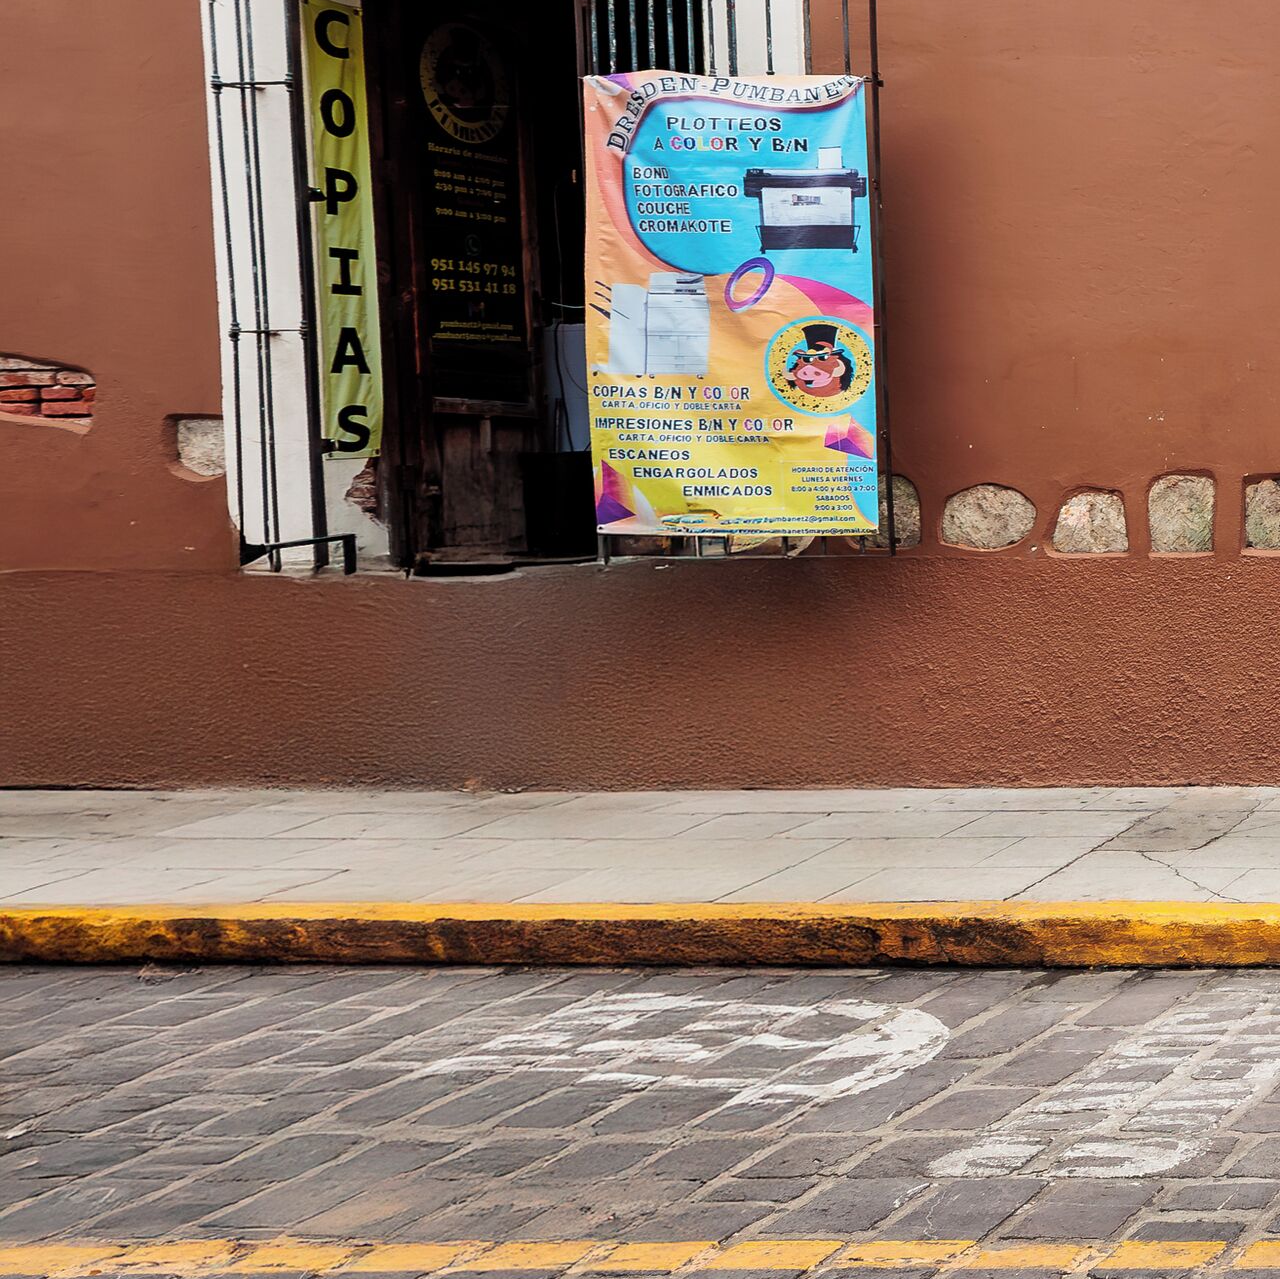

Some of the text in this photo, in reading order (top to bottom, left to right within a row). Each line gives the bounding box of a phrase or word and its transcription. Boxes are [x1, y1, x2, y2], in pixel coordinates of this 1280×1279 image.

[666, 116, 782, 132] PLOTTEOS
[653, 136, 808, 153] A COLOR Y B/N
[633, 167, 669, 179] BOND
[635, 184, 738, 197] FOTOGRAFICO
[637, 202, 691, 214] COUCHE
[314, 9, 372, 454] COPIAS
[639, 219, 732, 233] CROMAKOTE
[431, 258, 516, 277] 951 145 97 94
[432, 278, 517, 295] 951 531 41 18
[592, 385, 648, 399] COPIAS
[653, 386, 682, 400] B/N
[687, 386, 698, 400] Y
[674, 402, 680, 410] Y
[683, 402, 711, 410] DOBLE
[712, 402, 742, 410] CARTA
[595, 417, 693, 431] IMPRESIONES
[698, 418, 723, 432] B/N
[728, 419, 738, 431] Y
[696, 435, 702, 443] Y
[706, 435, 734, 443] DOBLE
[736, 435, 770, 443] CARTA
[609, 448, 691, 461] ESCANEOS
[633, 466, 758, 479] ENGARGOLADOS
[836, 464, 874, 473] ATENCIÓN
[683, 485, 773, 497] ENMICADOS
